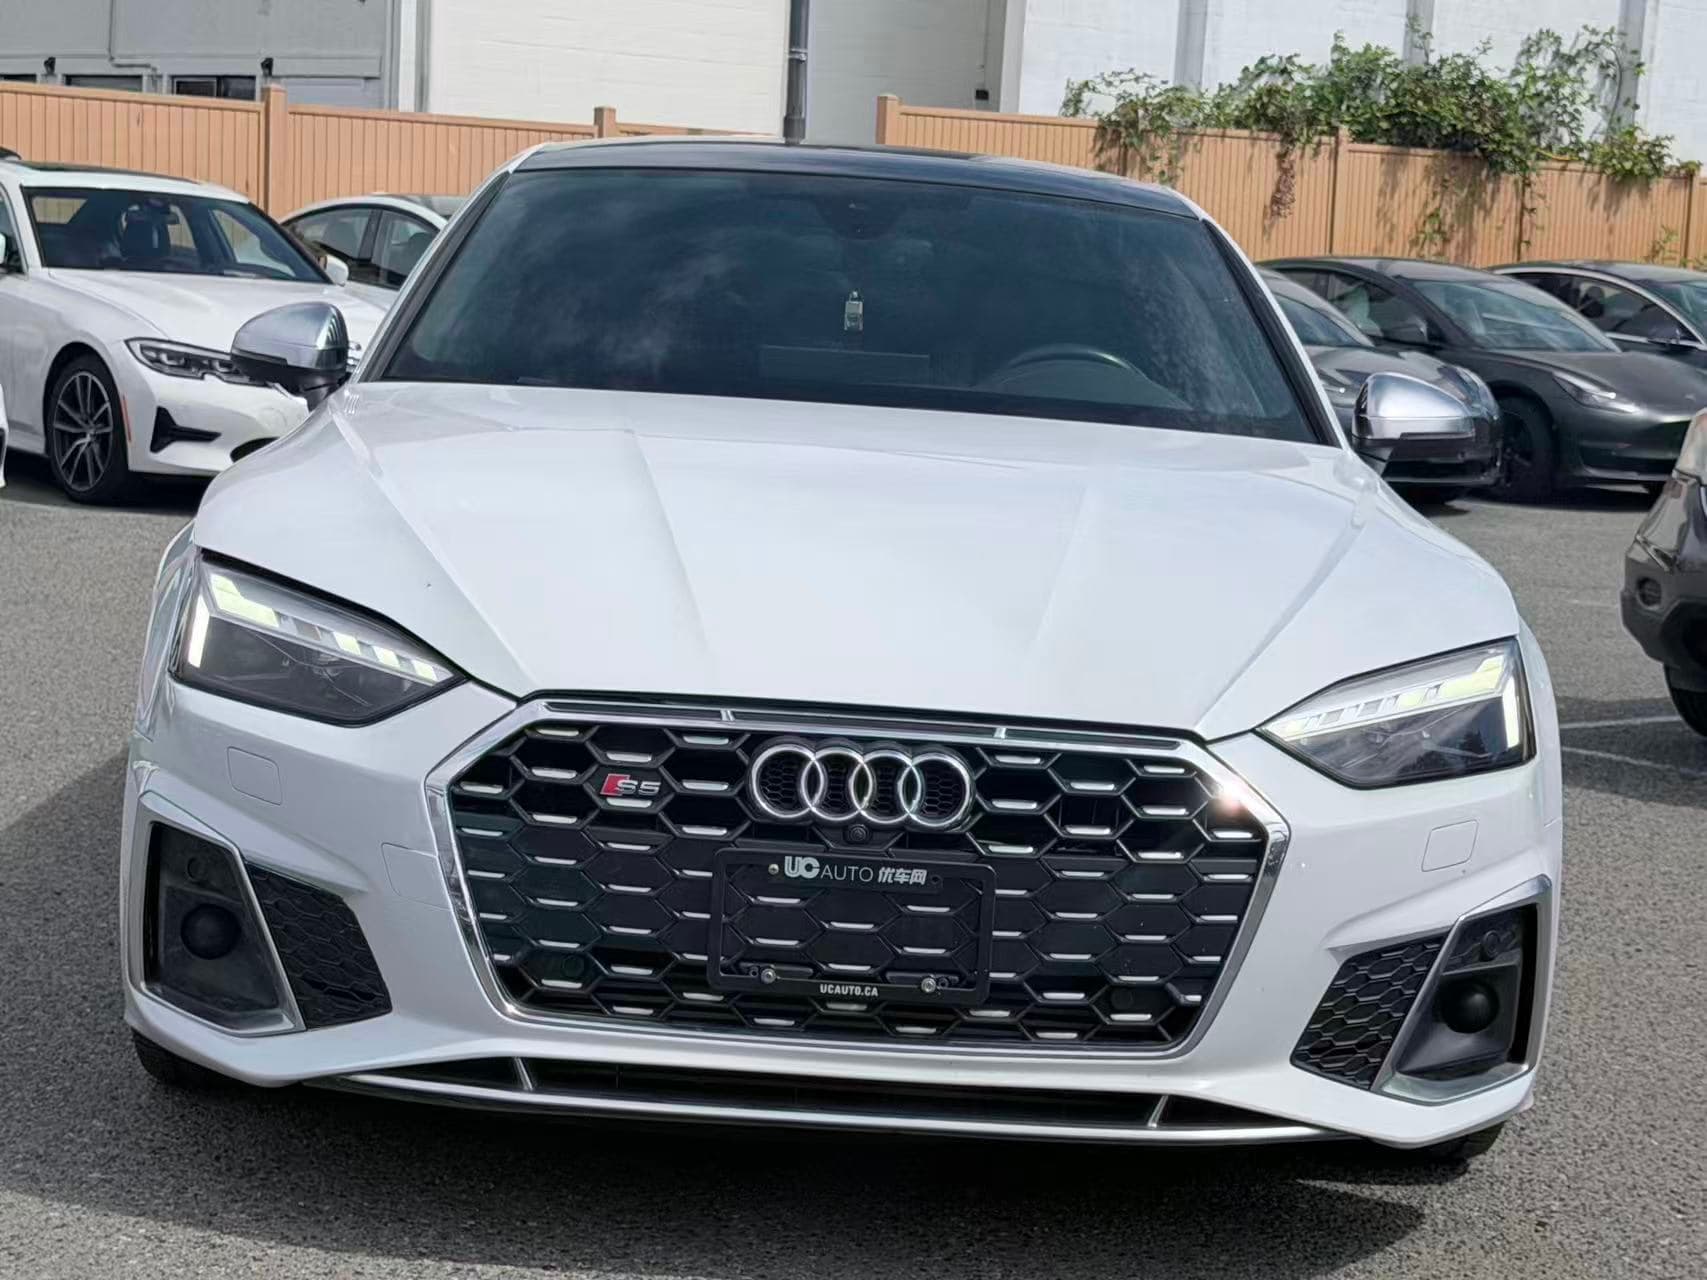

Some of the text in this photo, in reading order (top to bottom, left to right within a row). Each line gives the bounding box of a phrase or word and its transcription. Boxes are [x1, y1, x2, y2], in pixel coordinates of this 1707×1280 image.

[616, 780, 661, 796] S5
[878, 867, 928, 885] 优车网
[819, 983, 879, 997] UCAUTO.CA
